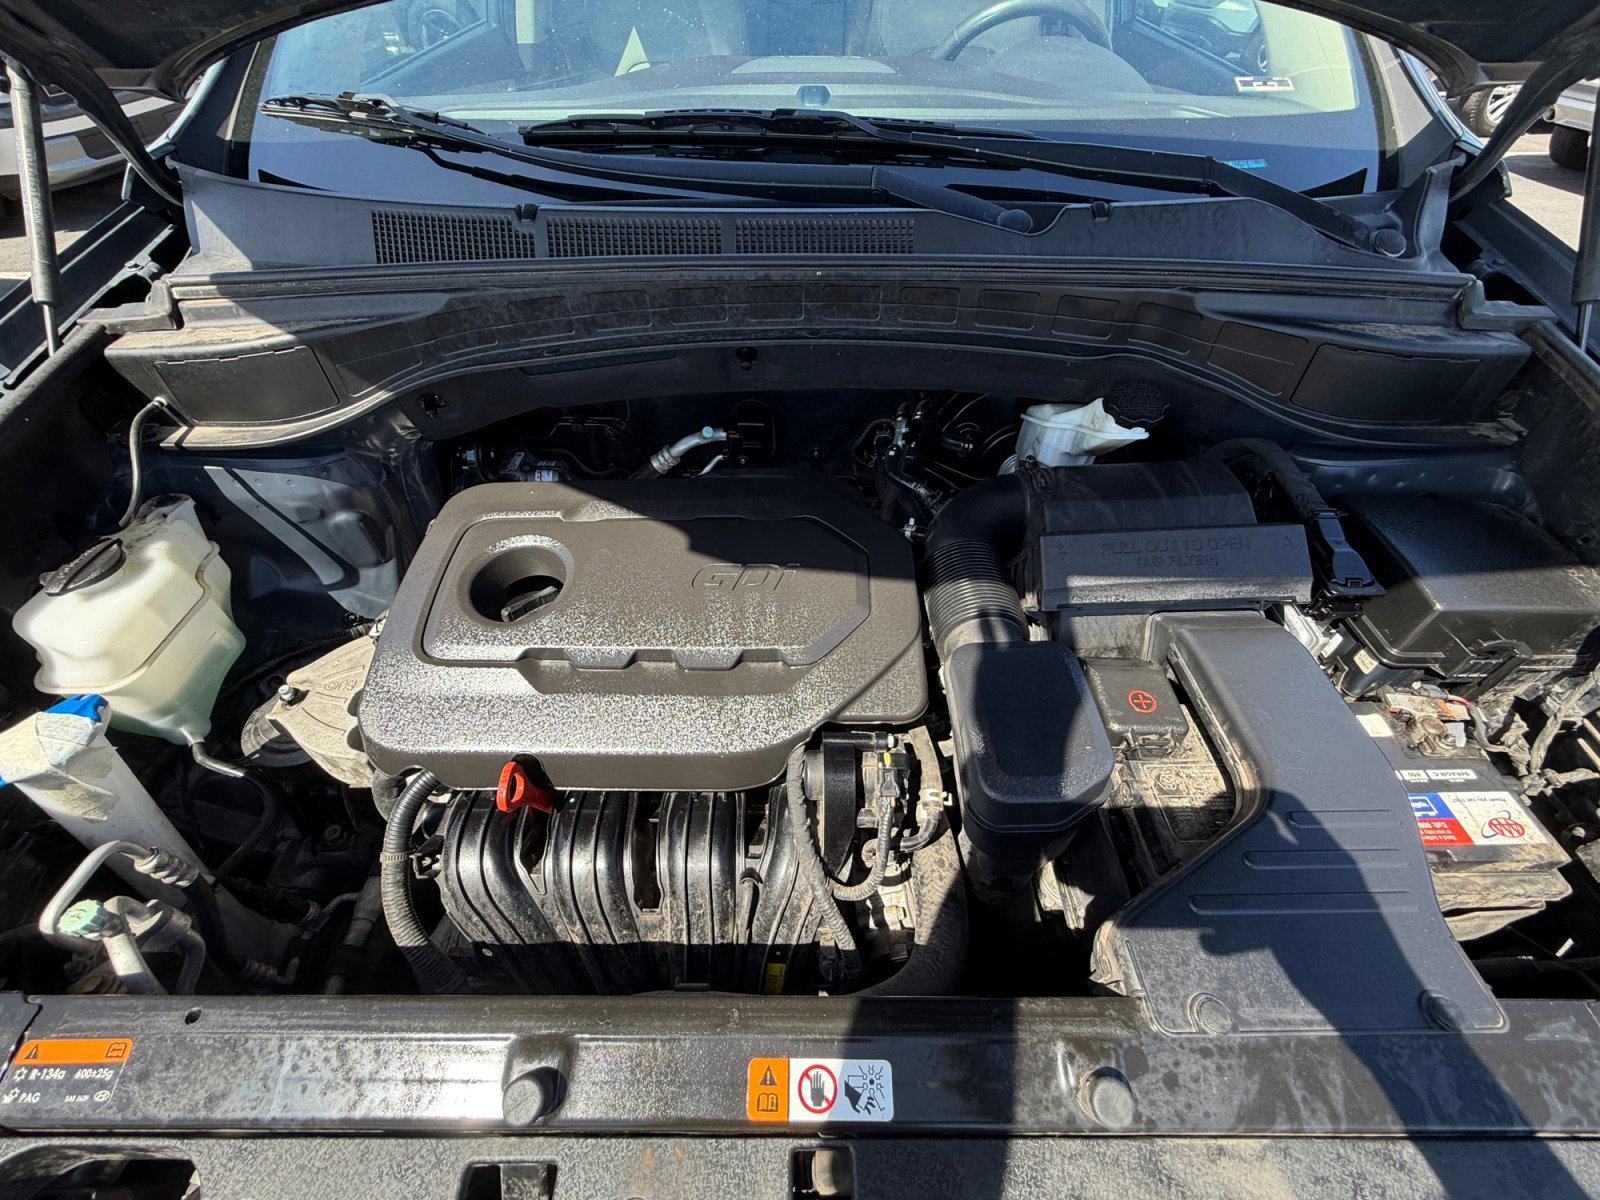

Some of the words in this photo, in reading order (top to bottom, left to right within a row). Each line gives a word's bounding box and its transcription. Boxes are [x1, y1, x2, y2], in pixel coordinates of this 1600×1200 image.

[1101, 541, 1142, 555] PULL
[1146, 539, 1177, 553] OUT
[1180, 538, 1204, 552] TO
[1207, 536, 1250, 551] OPEN
[29, 1068, 66, 1080] R-134a
[74, 1068, 115, 1081] 600±25g
[18, 1092, 41, 1103] PAG
